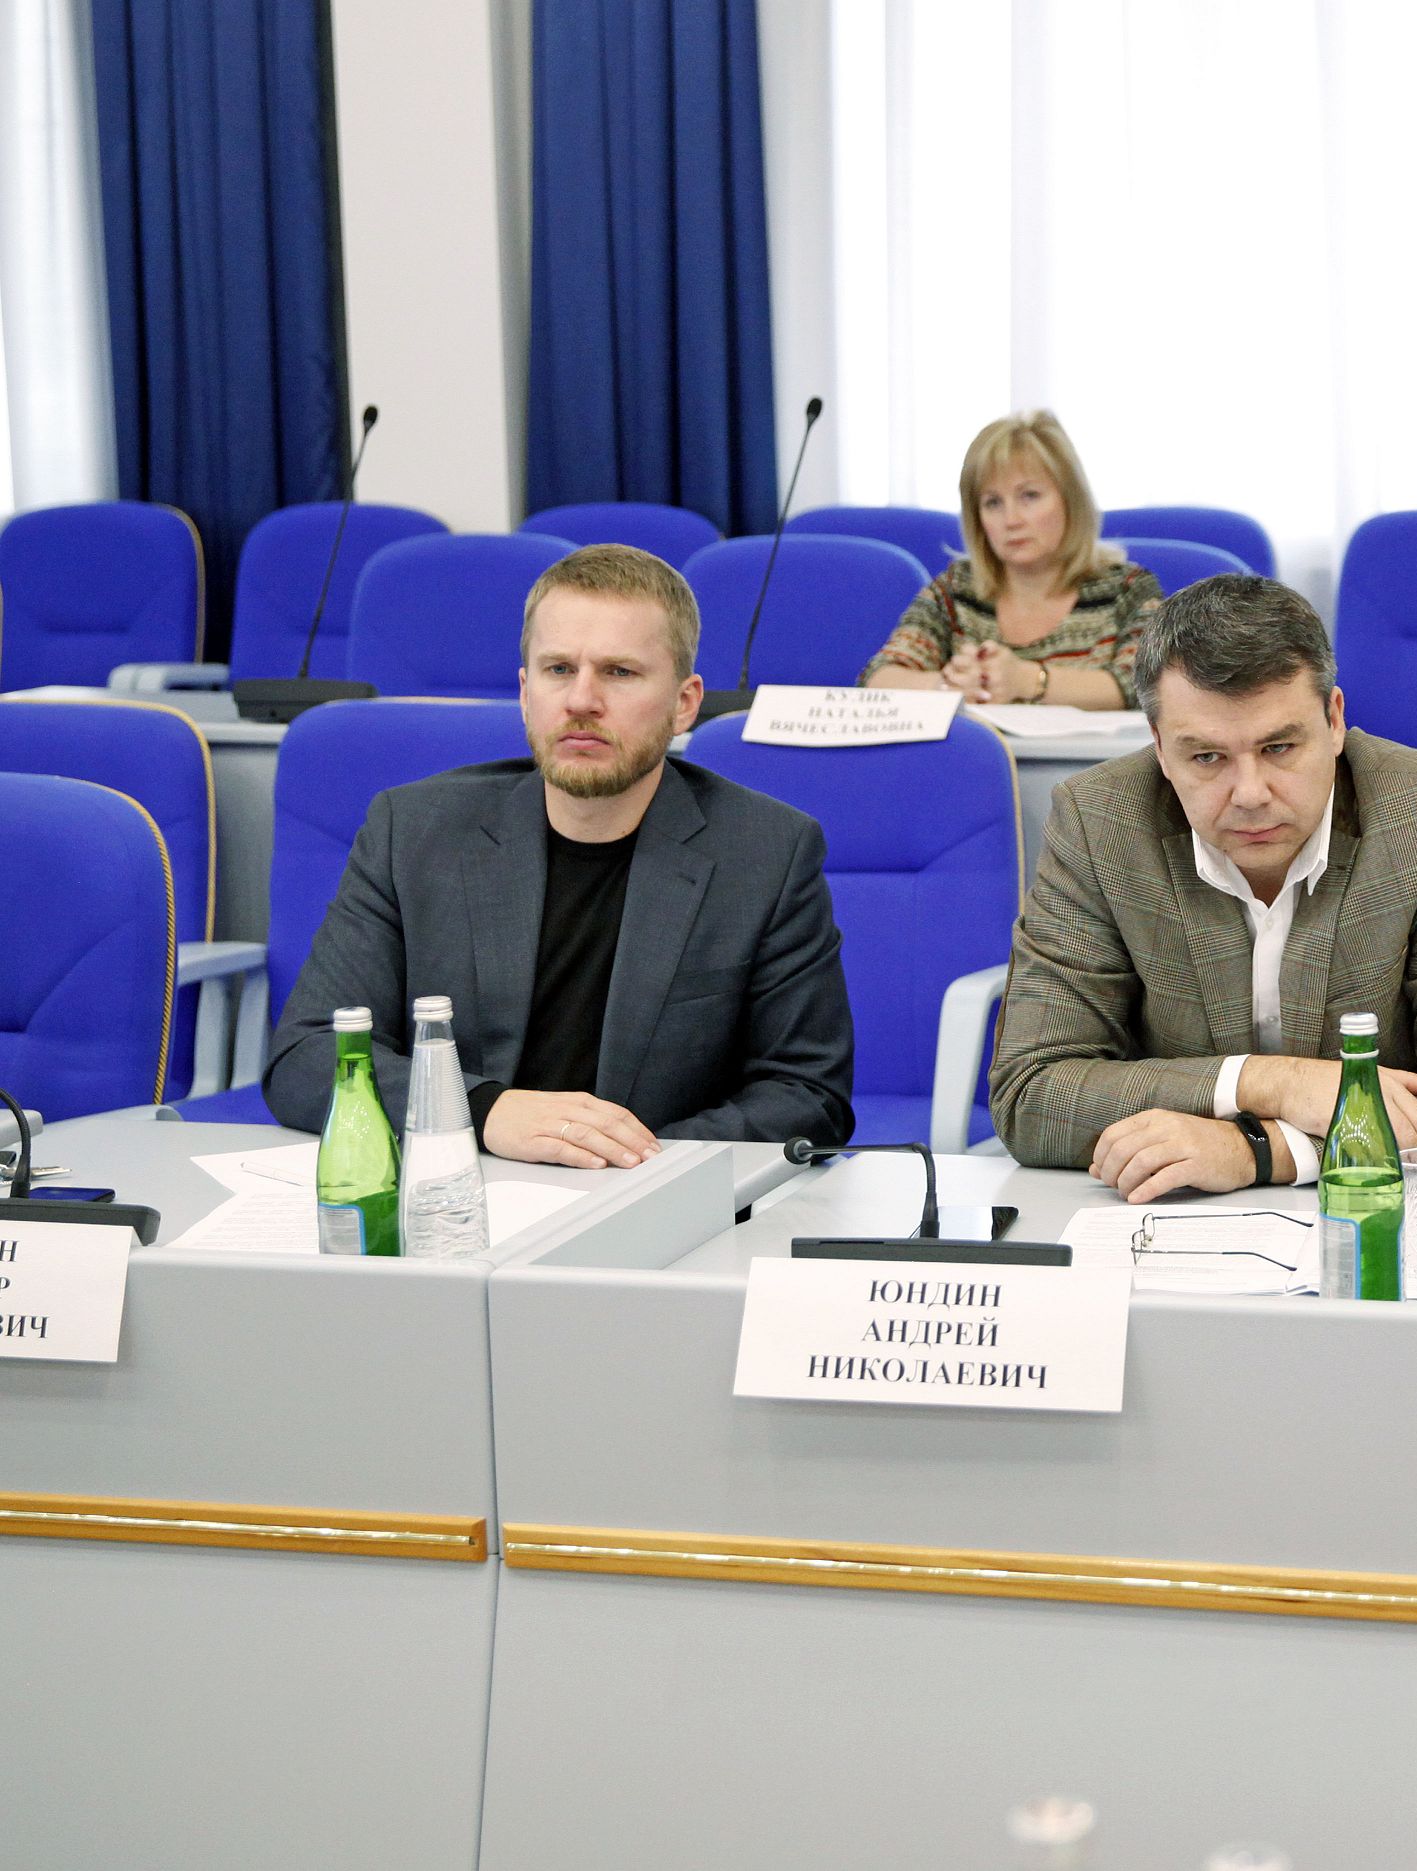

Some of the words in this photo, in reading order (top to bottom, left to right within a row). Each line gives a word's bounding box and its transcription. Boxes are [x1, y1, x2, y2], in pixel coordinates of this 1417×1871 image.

[868, 1279, 1003, 1311] ЮНДИН
[861, 1316, 1000, 1349] АНДРЕЙ
[807, 1354, 1049, 1389] НИКОЛАЕВИЧ
